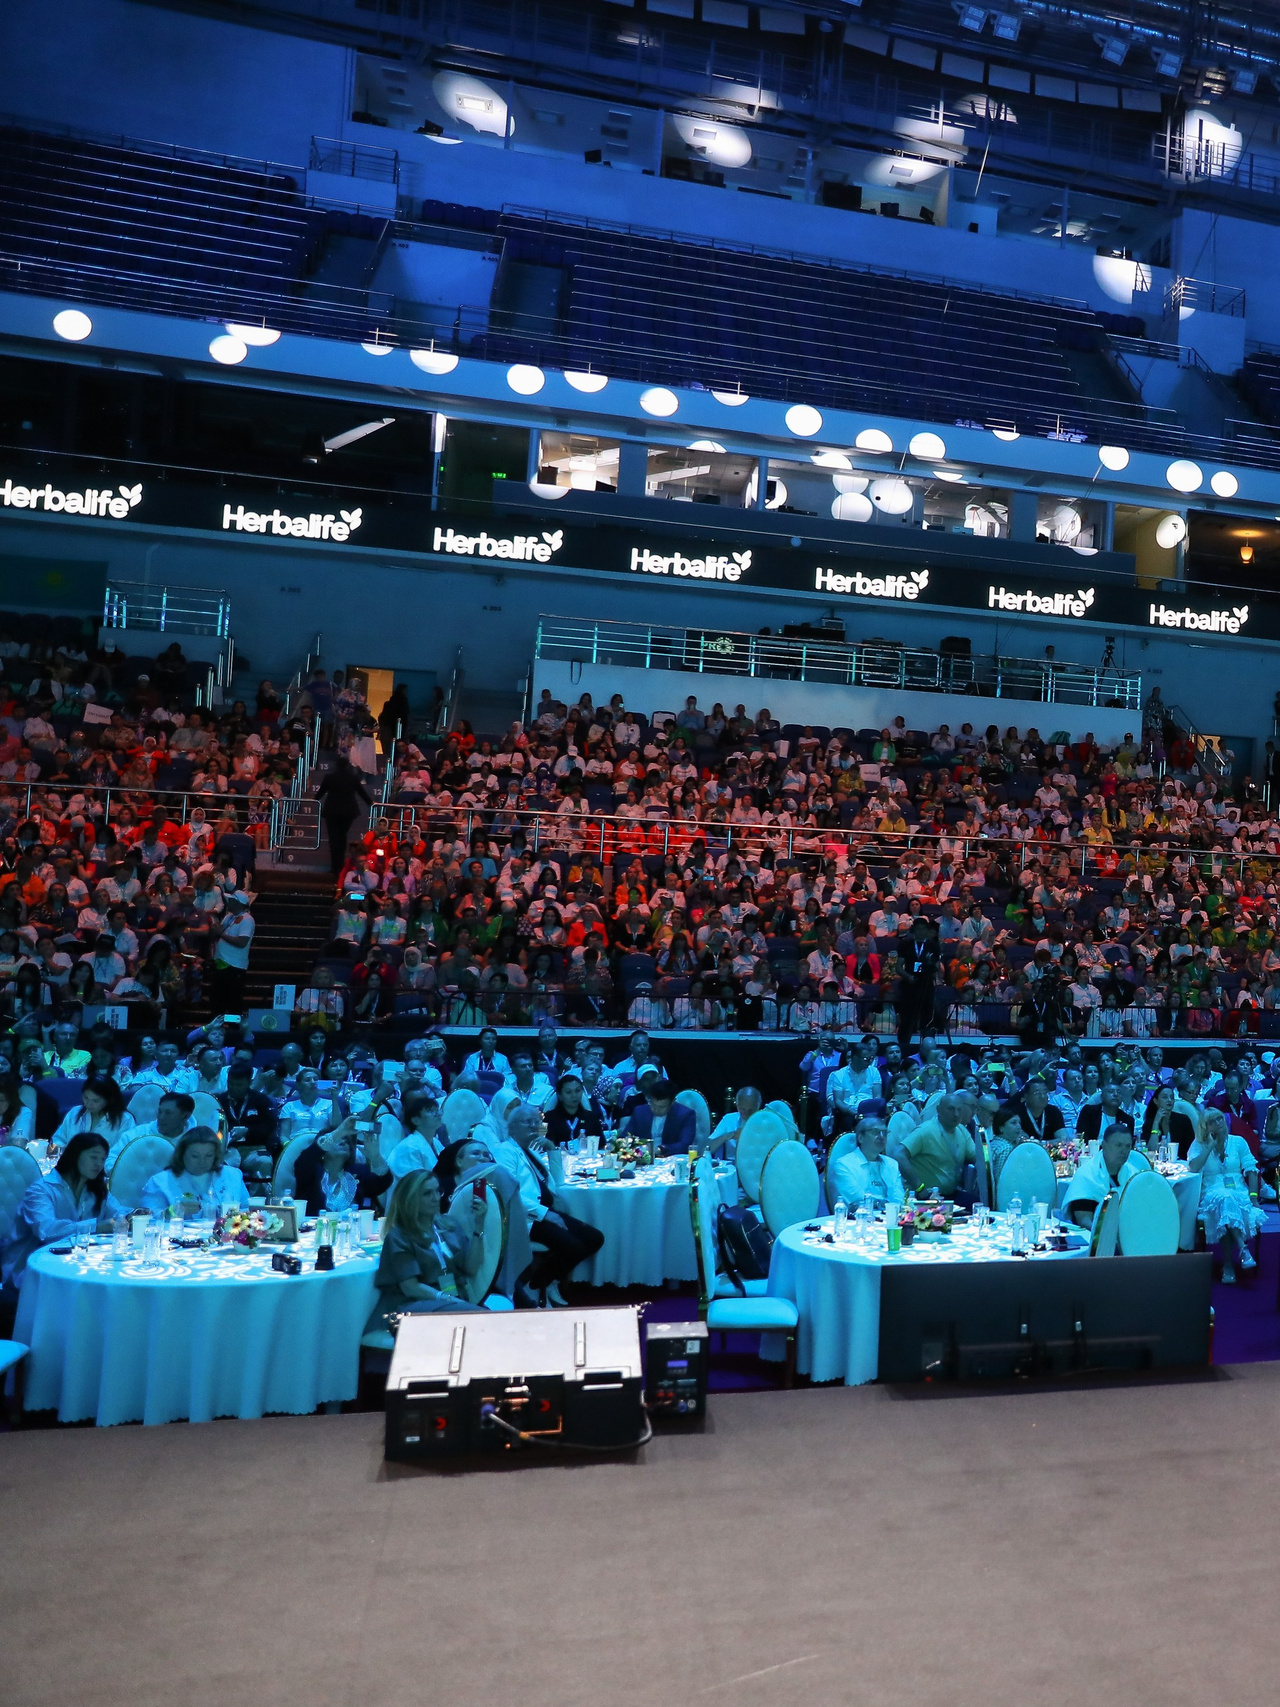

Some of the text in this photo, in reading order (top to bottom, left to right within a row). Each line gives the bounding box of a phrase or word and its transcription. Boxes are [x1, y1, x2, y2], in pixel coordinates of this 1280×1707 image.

[223, 504, 350, 541] Herbalife
[433, 528, 552, 562] Herbalife
[631, 547, 741, 582] Herbalife
[815, 567, 919, 599] Herbalife
[989, 585, 1084, 616] Herbalife
[1149, 603, 1240, 634] Herbalife
[373, 788, 383, 796] 12
